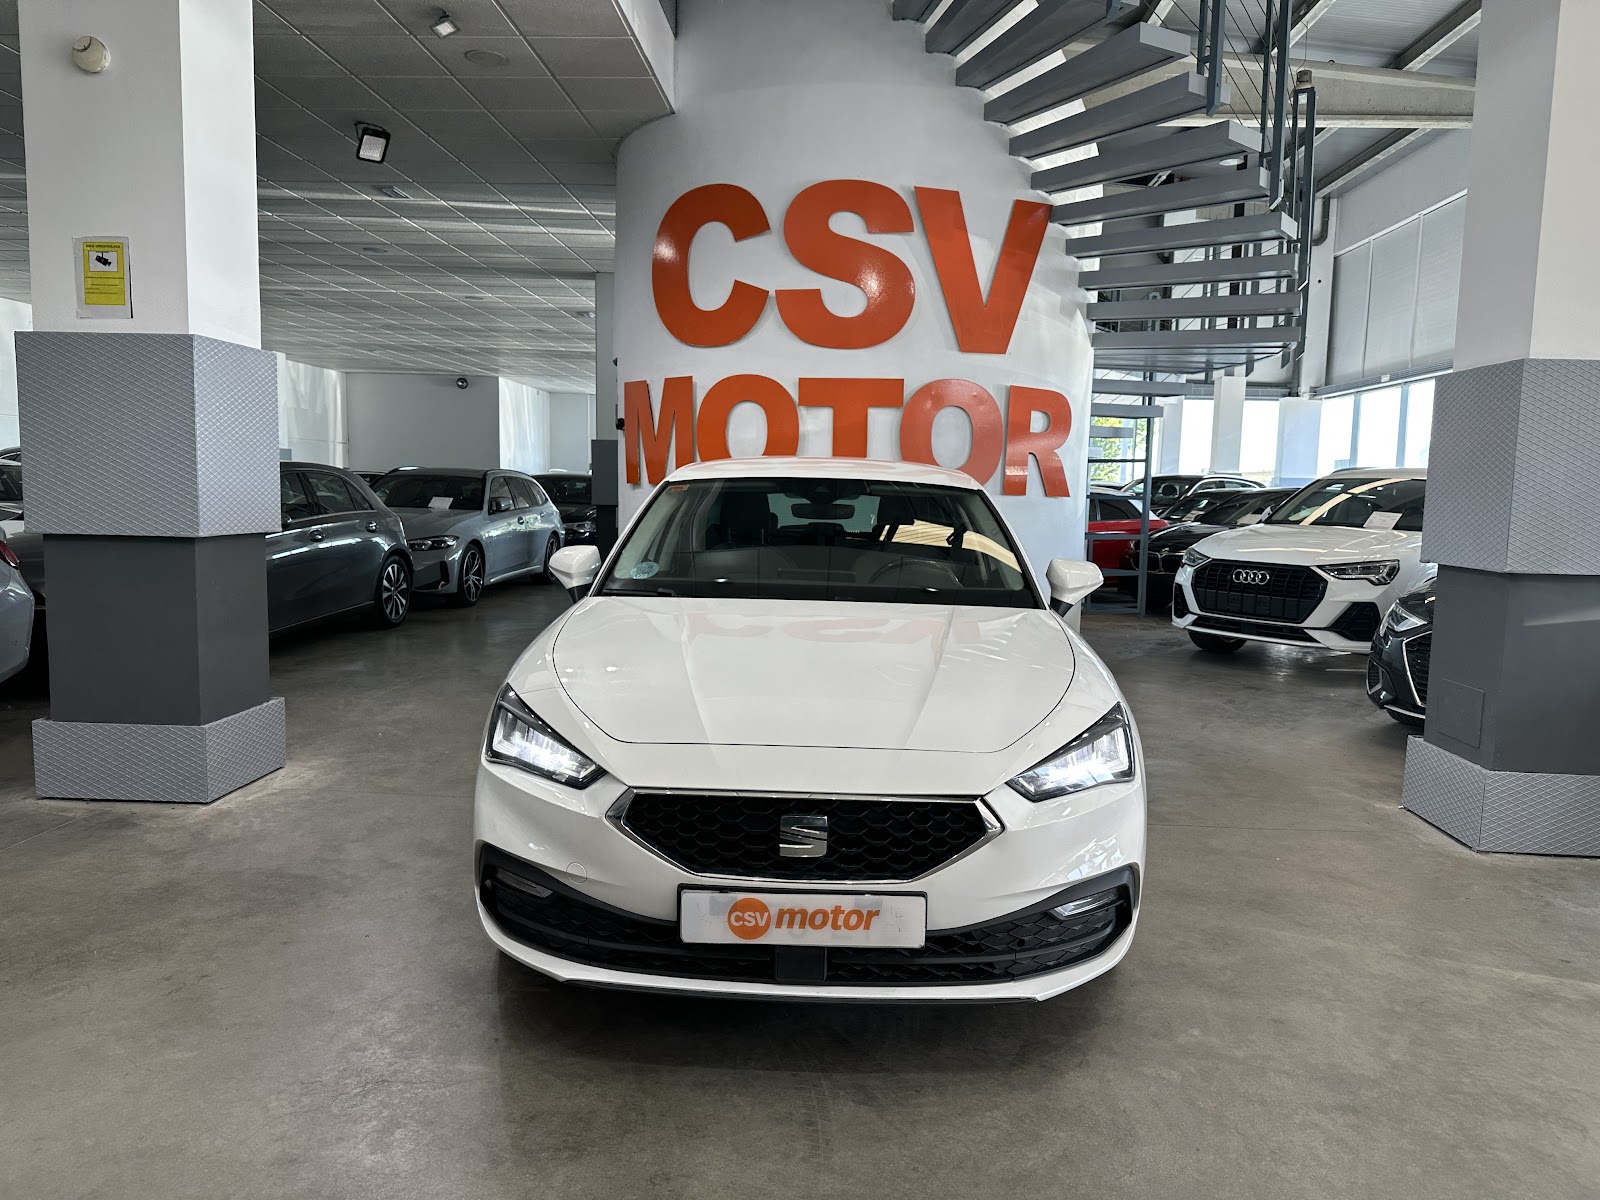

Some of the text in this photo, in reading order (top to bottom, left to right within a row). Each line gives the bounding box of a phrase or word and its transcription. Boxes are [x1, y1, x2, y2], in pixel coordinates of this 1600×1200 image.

[652, 179, 1053, 354] CSV
[624, 374, 1072, 497] MOTOR
[730, 905, 880, 930] CSV motor
